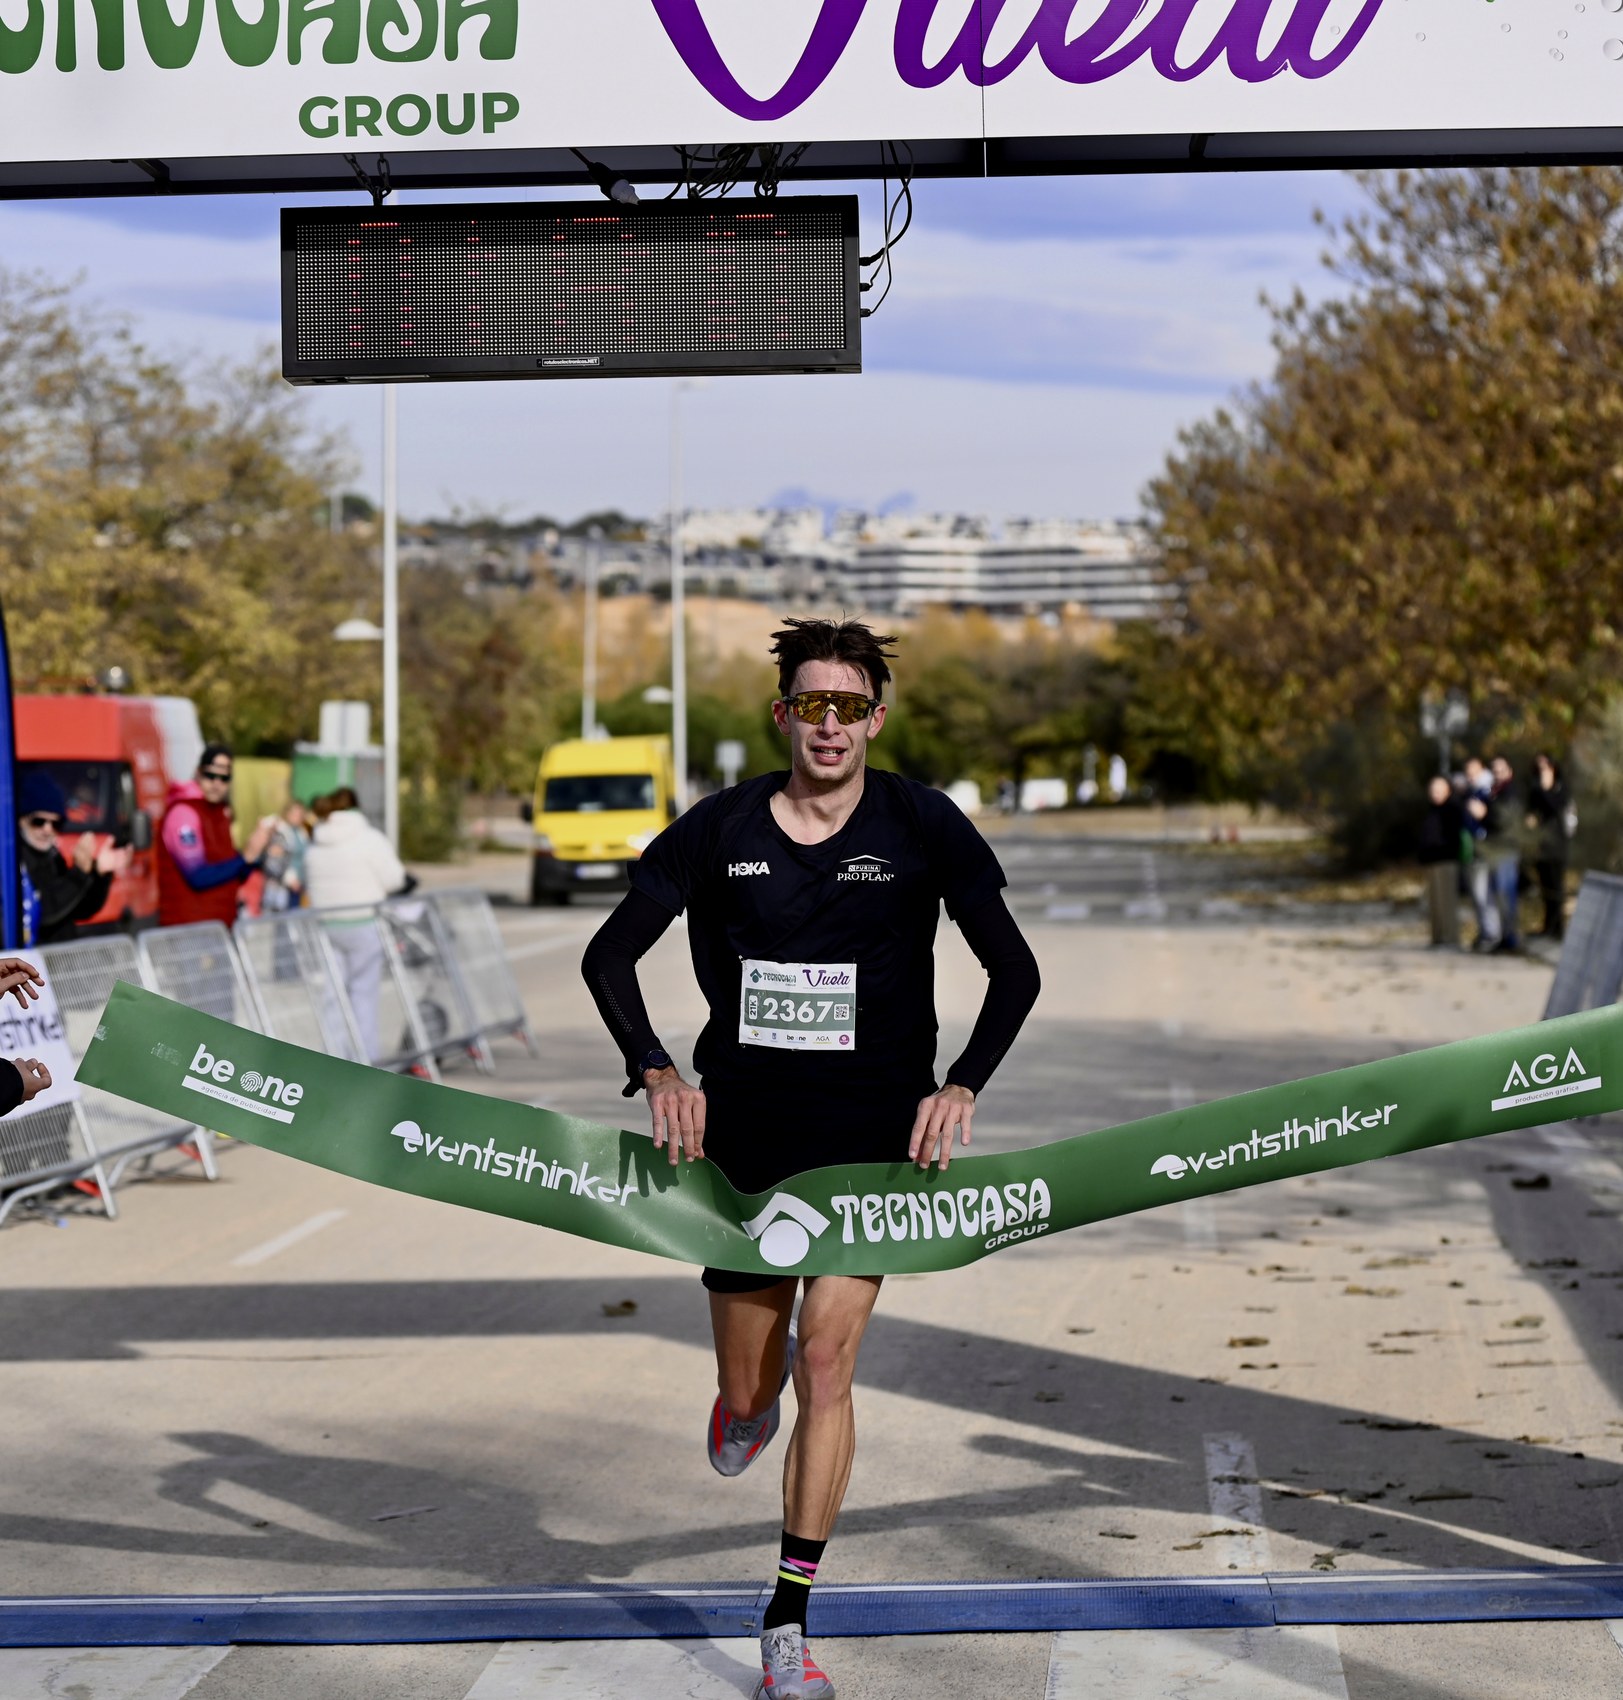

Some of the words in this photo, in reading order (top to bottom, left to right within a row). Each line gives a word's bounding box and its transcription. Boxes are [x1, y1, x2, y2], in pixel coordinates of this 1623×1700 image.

[299, 92, 520, 138] GROUP
[728, 861, 770, 877] HOKA
[837, 873, 860, 881] PRO
[802, 969, 851, 987] Vuela
[749, 1000, 757, 1016] 21K
[763, 997, 834, 1023] 2367
[189, 1043, 235, 1083] be
[1502, 1046, 1587, 1093] AGA
[201, 1085, 229, 1102] agencia
[230, 1095, 239, 1103] de
[239, 1100, 277, 1117] publicidad
[1515, 1091, 1554, 1104] producción
[1555, 1085, 1580, 1096] gráfica
[1166, 1103, 1398, 1180] eventsthinker
[402, 1130, 639, 1207] eventsthinker
[831, 1178, 1051, 1244] TECNOCASA
[984, 1223, 1049, 1250] GROUP
